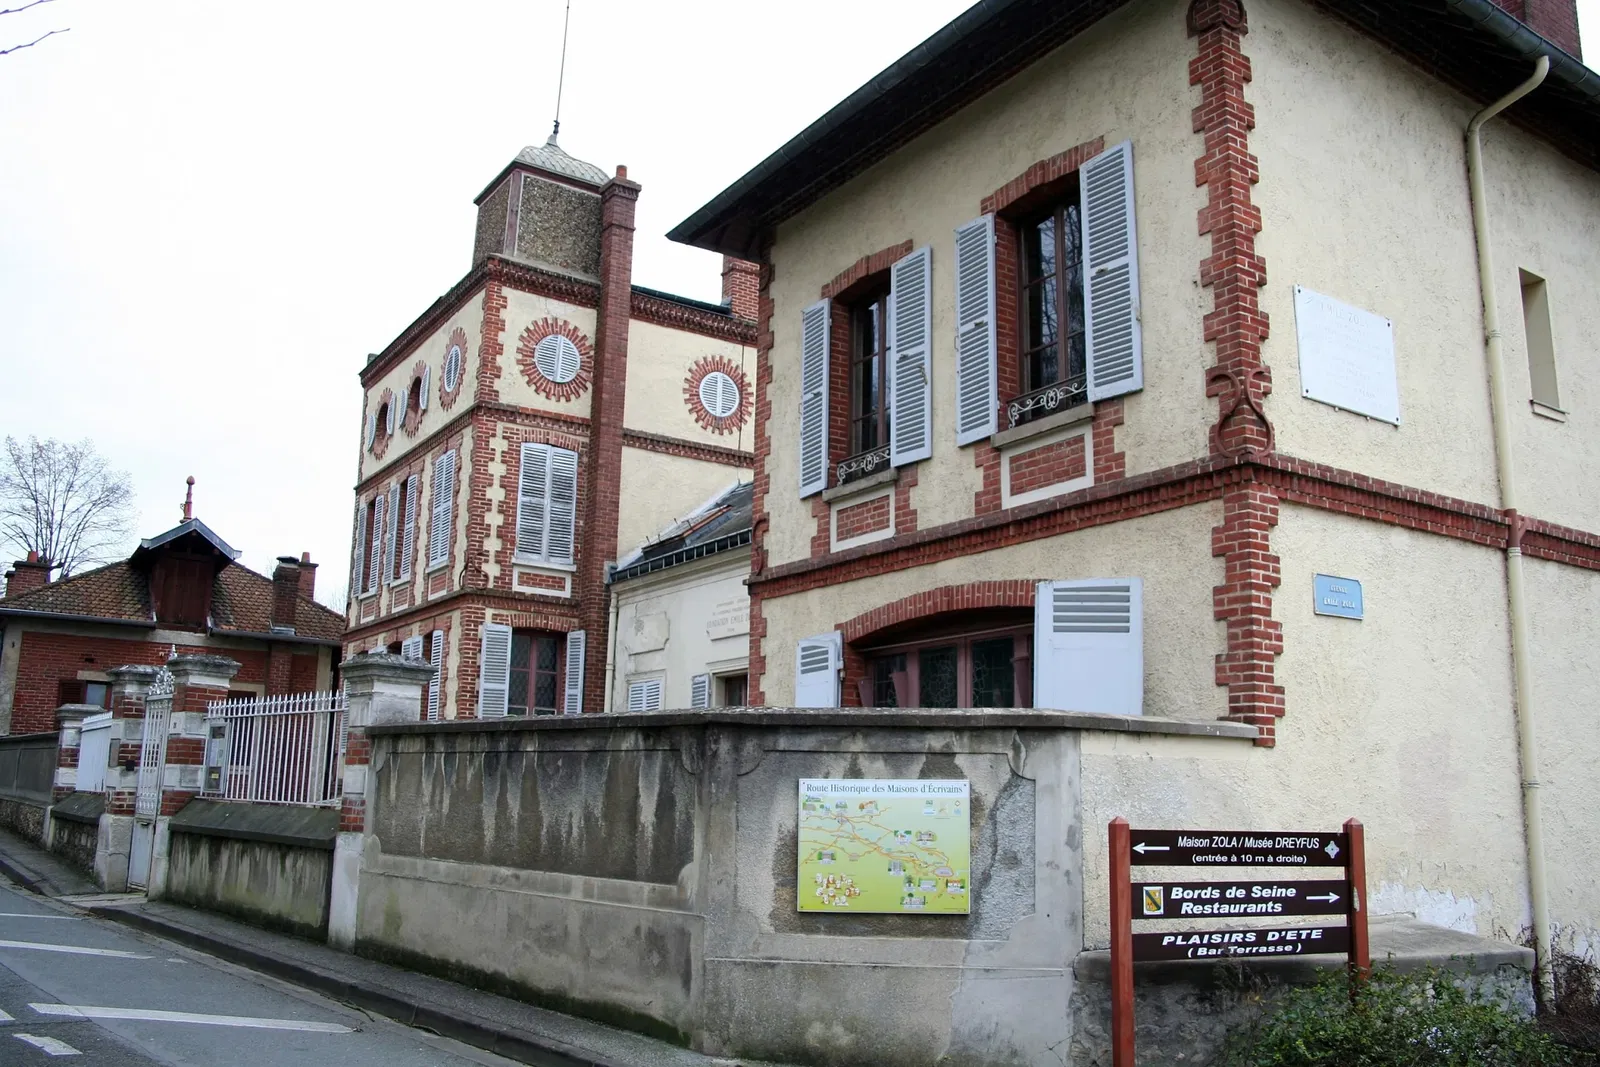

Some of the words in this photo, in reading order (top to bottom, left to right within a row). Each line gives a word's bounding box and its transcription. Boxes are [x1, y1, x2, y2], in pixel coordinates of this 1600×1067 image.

[806, 784, 828, 792] Route
[830, 784, 870, 794] Historique
[872, 784, 885, 792] des
[887, 785, 918, 793] Maisons
[921, 783, 963, 793] d'Écrivains
[1178, 836, 1210, 848] Maison
[1212, 837, 1237, 847] ZOLA
[1244, 837, 1273, 848] Musée
[1275, 838, 1319, 848] DREYFUS
[1192, 854, 1228, 864] (entrée
[1230, 854, 1237, 862] à
[1267, 854, 1274, 862] à
[1276, 854, 1307, 864] droite)
[1171, 887, 1220, 899] Bords
[1226, 887, 1246, 898] de
[1251, 886, 1296, 898] Seine
[1181, 900, 1282, 914] Restaurants
[1162, 933, 1256, 945] PLAISIRS
[1267, 929, 1323, 941] D'ETE
[1196, 946, 1224, 956] Bar
[1228, 944, 1293, 954] Terrasse
